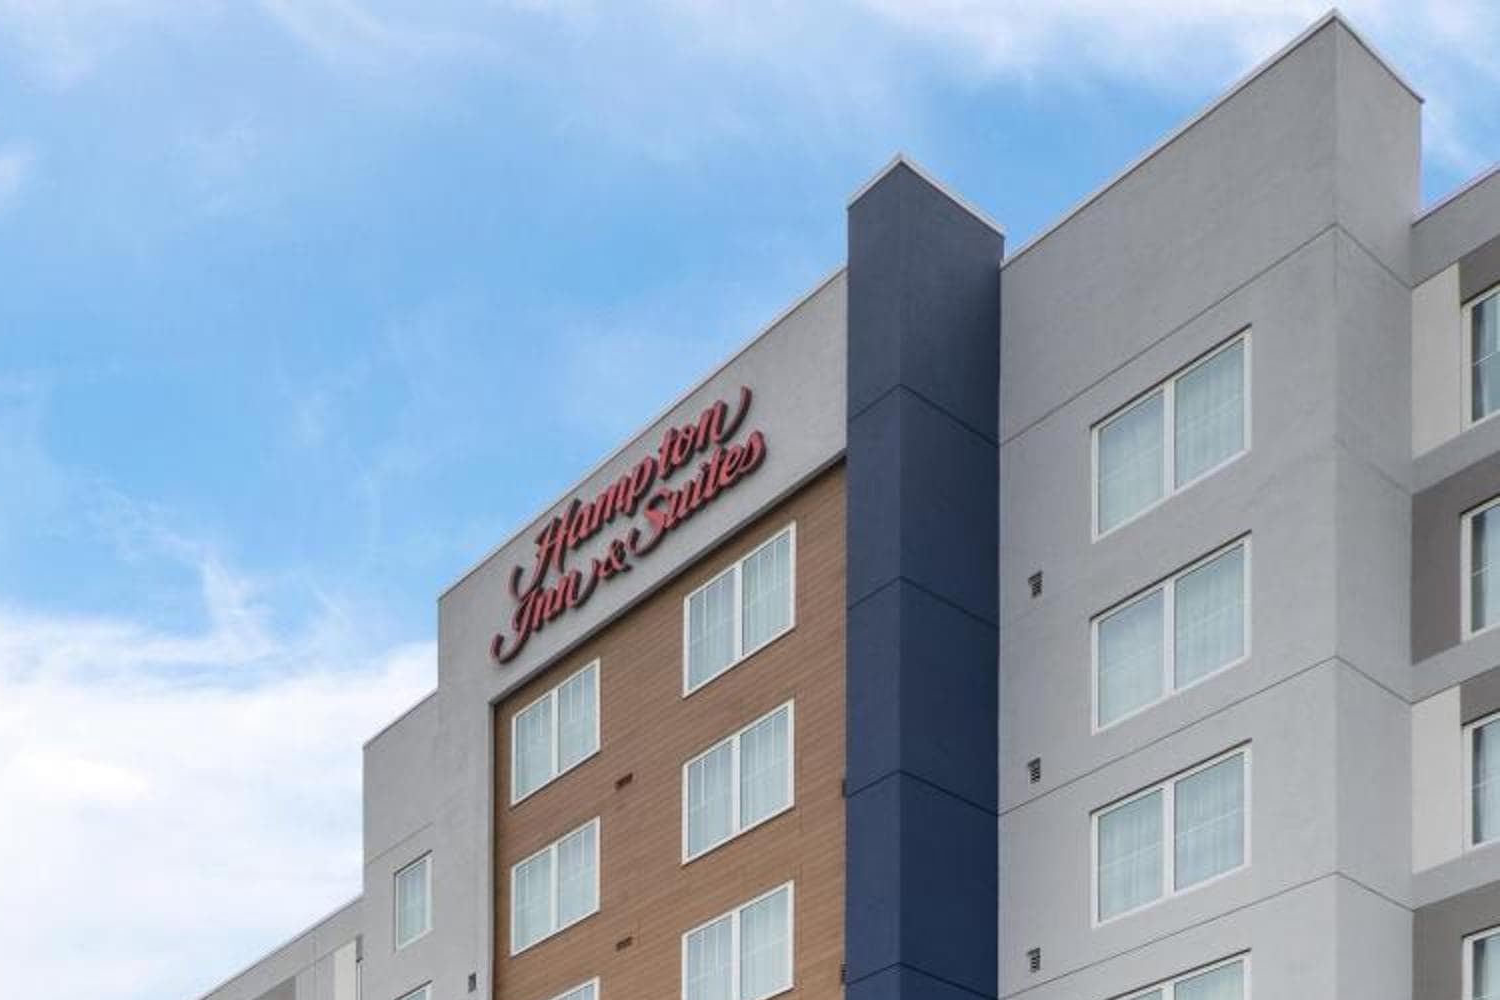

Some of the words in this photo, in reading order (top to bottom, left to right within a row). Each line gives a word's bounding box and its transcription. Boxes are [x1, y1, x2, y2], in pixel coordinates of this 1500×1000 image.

[490, 558, 600, 664] Inn
[601, 539, 632, 581] &
[630, 430, 766, 557] Suites
[510, 386, 752, 598] Hampton
